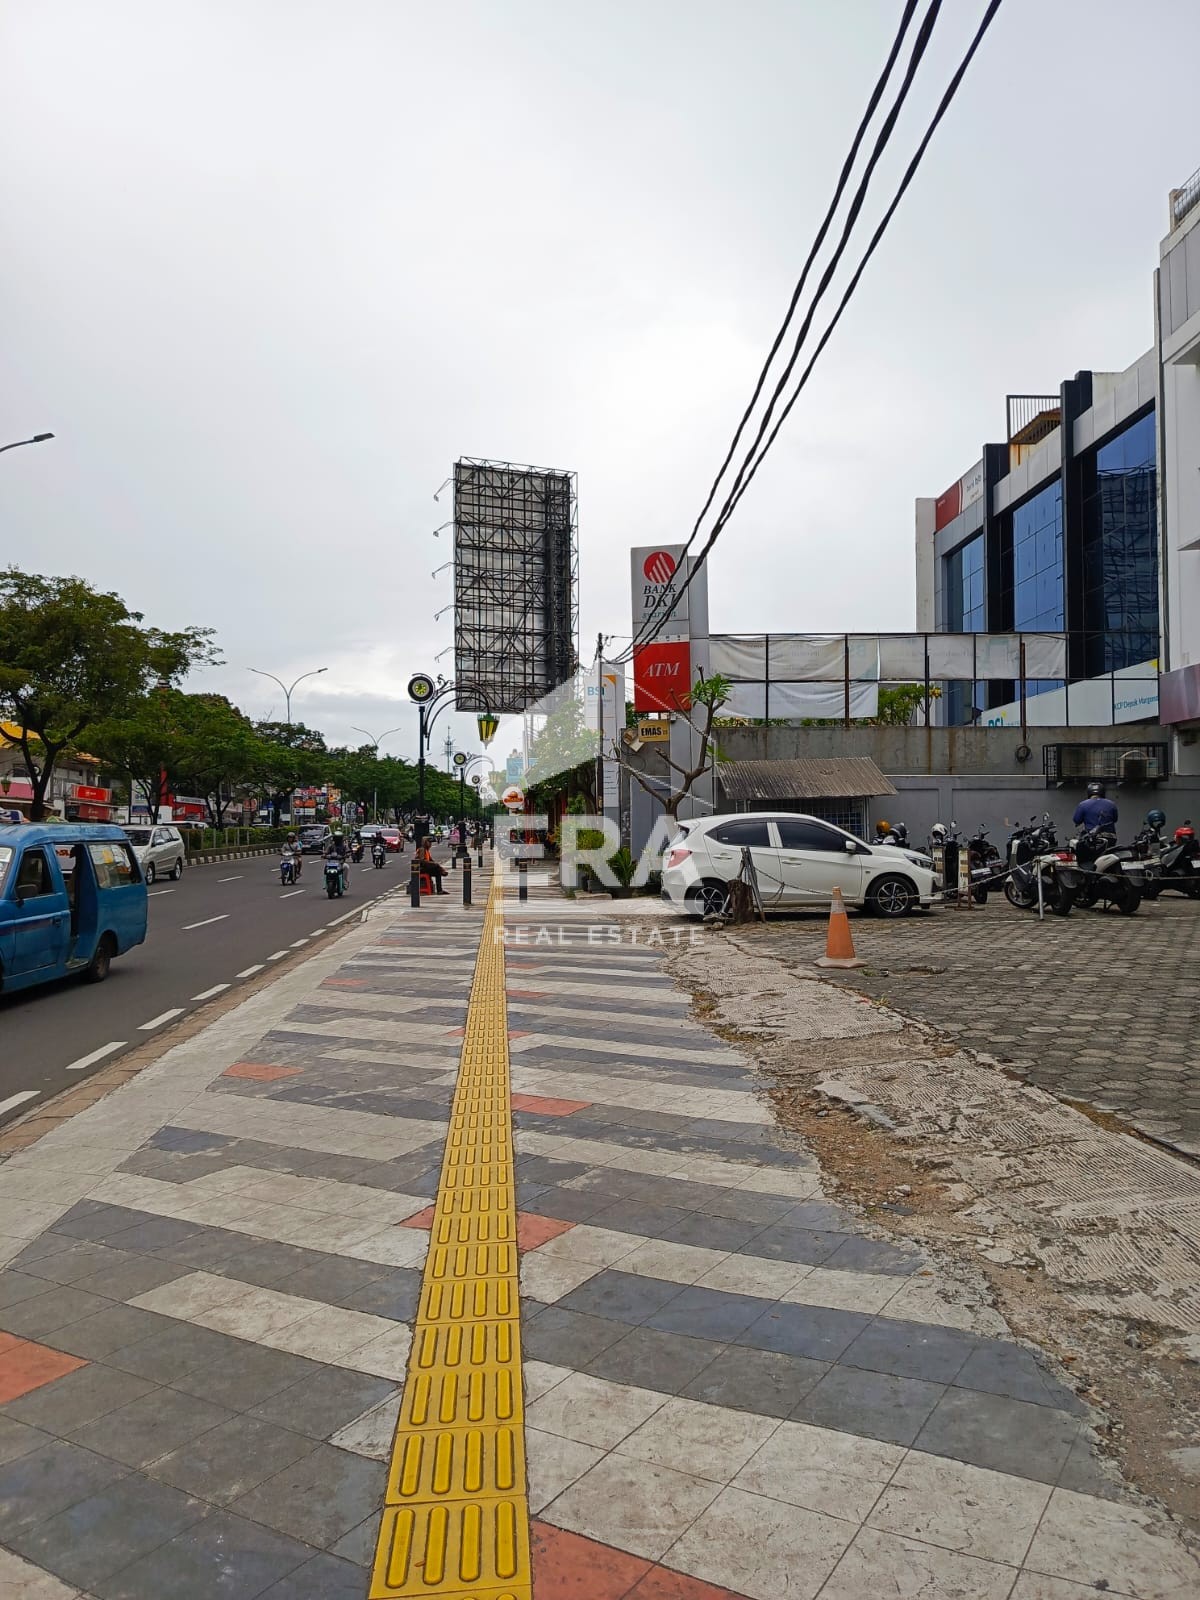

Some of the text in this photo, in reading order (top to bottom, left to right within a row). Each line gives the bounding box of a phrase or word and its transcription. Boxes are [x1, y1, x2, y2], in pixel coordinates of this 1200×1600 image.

[643, 584, 677, 595] BANK
[642, 662, 681, 678] ATM
[641, 727, 662, 737] EMAS
